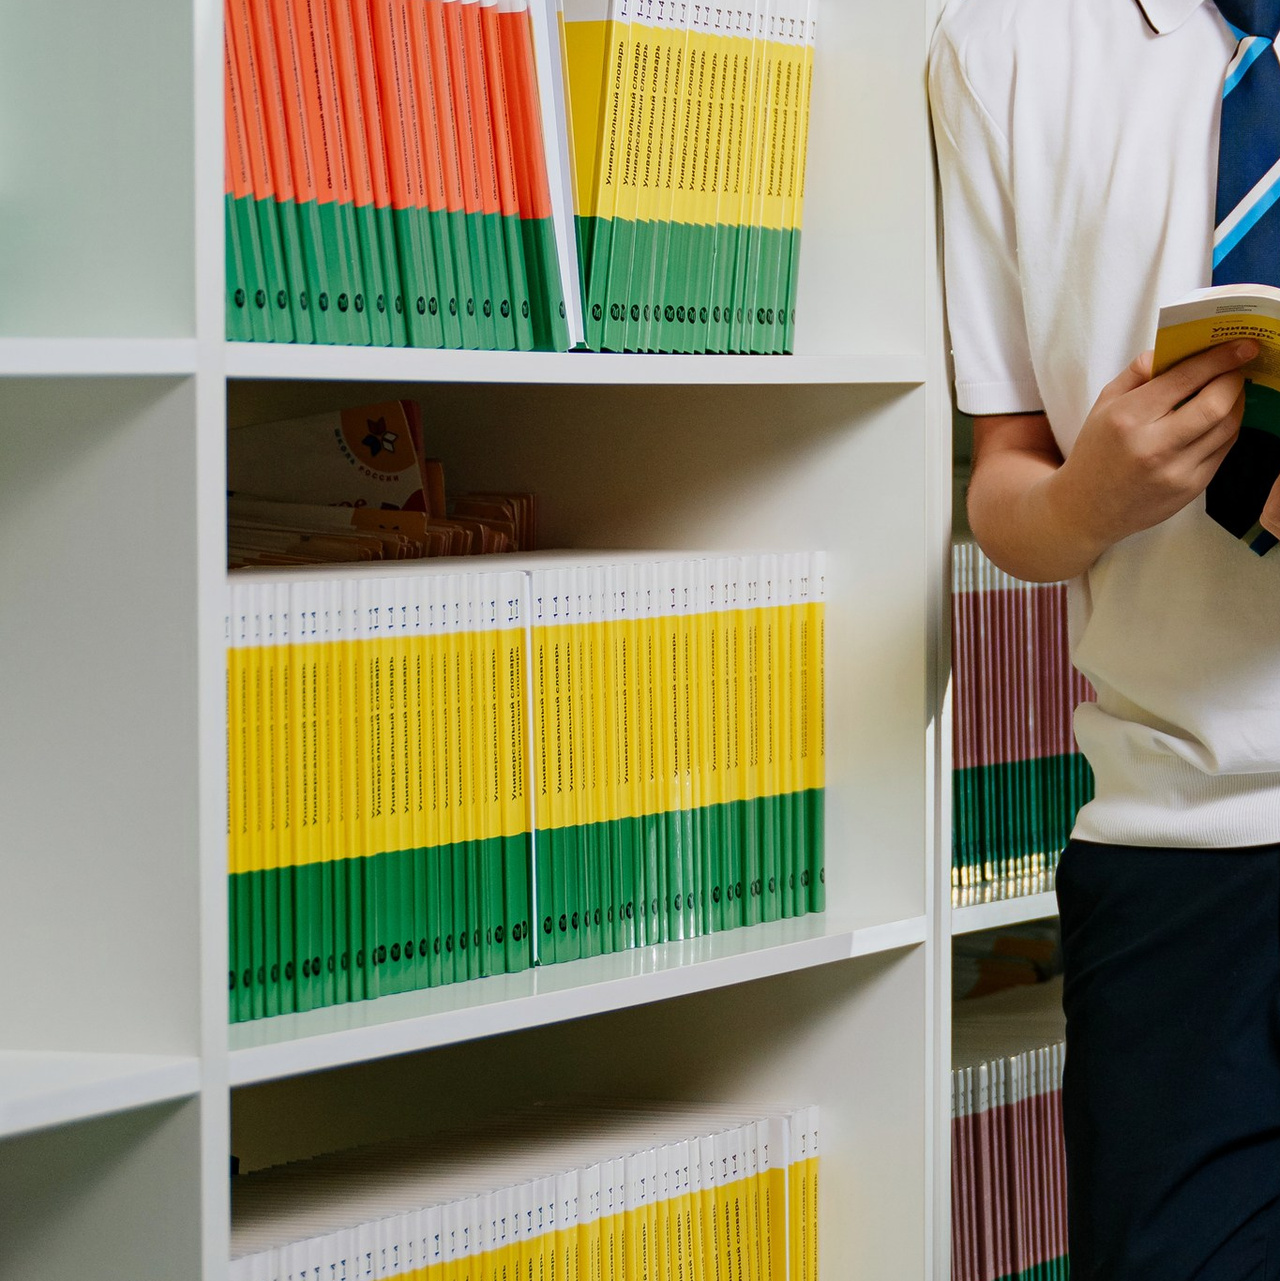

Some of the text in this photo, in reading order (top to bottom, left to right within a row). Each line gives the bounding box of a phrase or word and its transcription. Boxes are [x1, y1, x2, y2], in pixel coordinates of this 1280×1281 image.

[605, 92, 620, 185] Универсальный
[614, 41, 625, 89] словарь
[622, 92, 638, 185] Универсальный
[631, 42, 642, 90] словарь
[631, 94, 645, 187] Универсальный
[639, 44, 649, 92] словарь
[642, 95, 657, 187] Универсальный
[651, 45, 662, 93] словарь
[654, 96, 668, 188] Универсальный
[662, 46, 672, 94] словарь
[665, 98, 679, 189] Универсальный
[673, 48, 683, 95] словарь
[678, 99, 693, 190] Универсальный
[686, 49, 697, 96] словарь
[689, 100, 703, 191] Универсальный
[697, 51, 707, 98] словарь
[700, 102, 714, 192] Универсальный
[708, 53, 719, 99] словарь
[711, 103, 725, 193] Универсальный
[719, 54, 729, 100] словарь
[723, 103, 736, 192] Универсальный
[730, 54, 739, 100] словарь
[1211, 331, 1275, 340] словарь
